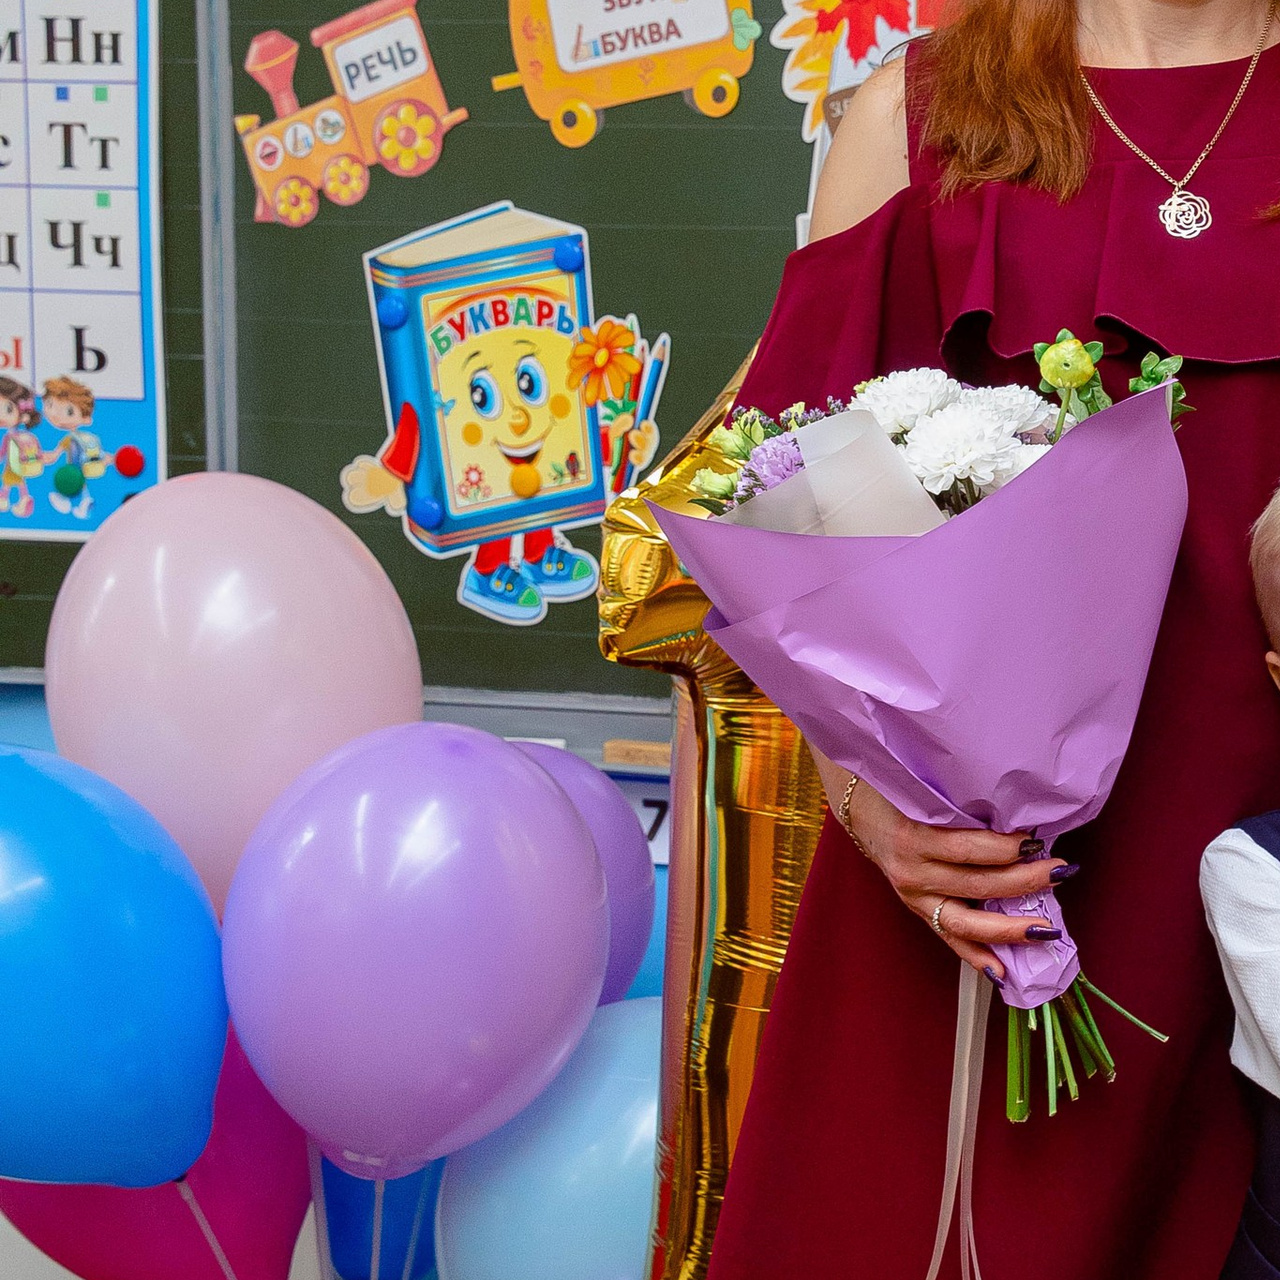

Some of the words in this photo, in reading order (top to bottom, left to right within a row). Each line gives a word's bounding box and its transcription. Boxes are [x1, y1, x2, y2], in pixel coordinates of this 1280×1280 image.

[600, 18, 683, 56] БУКВА
[344, 41, 418, 91] РЕЧЬ
[429, 296, 576, 357] БУКВАРЬ
